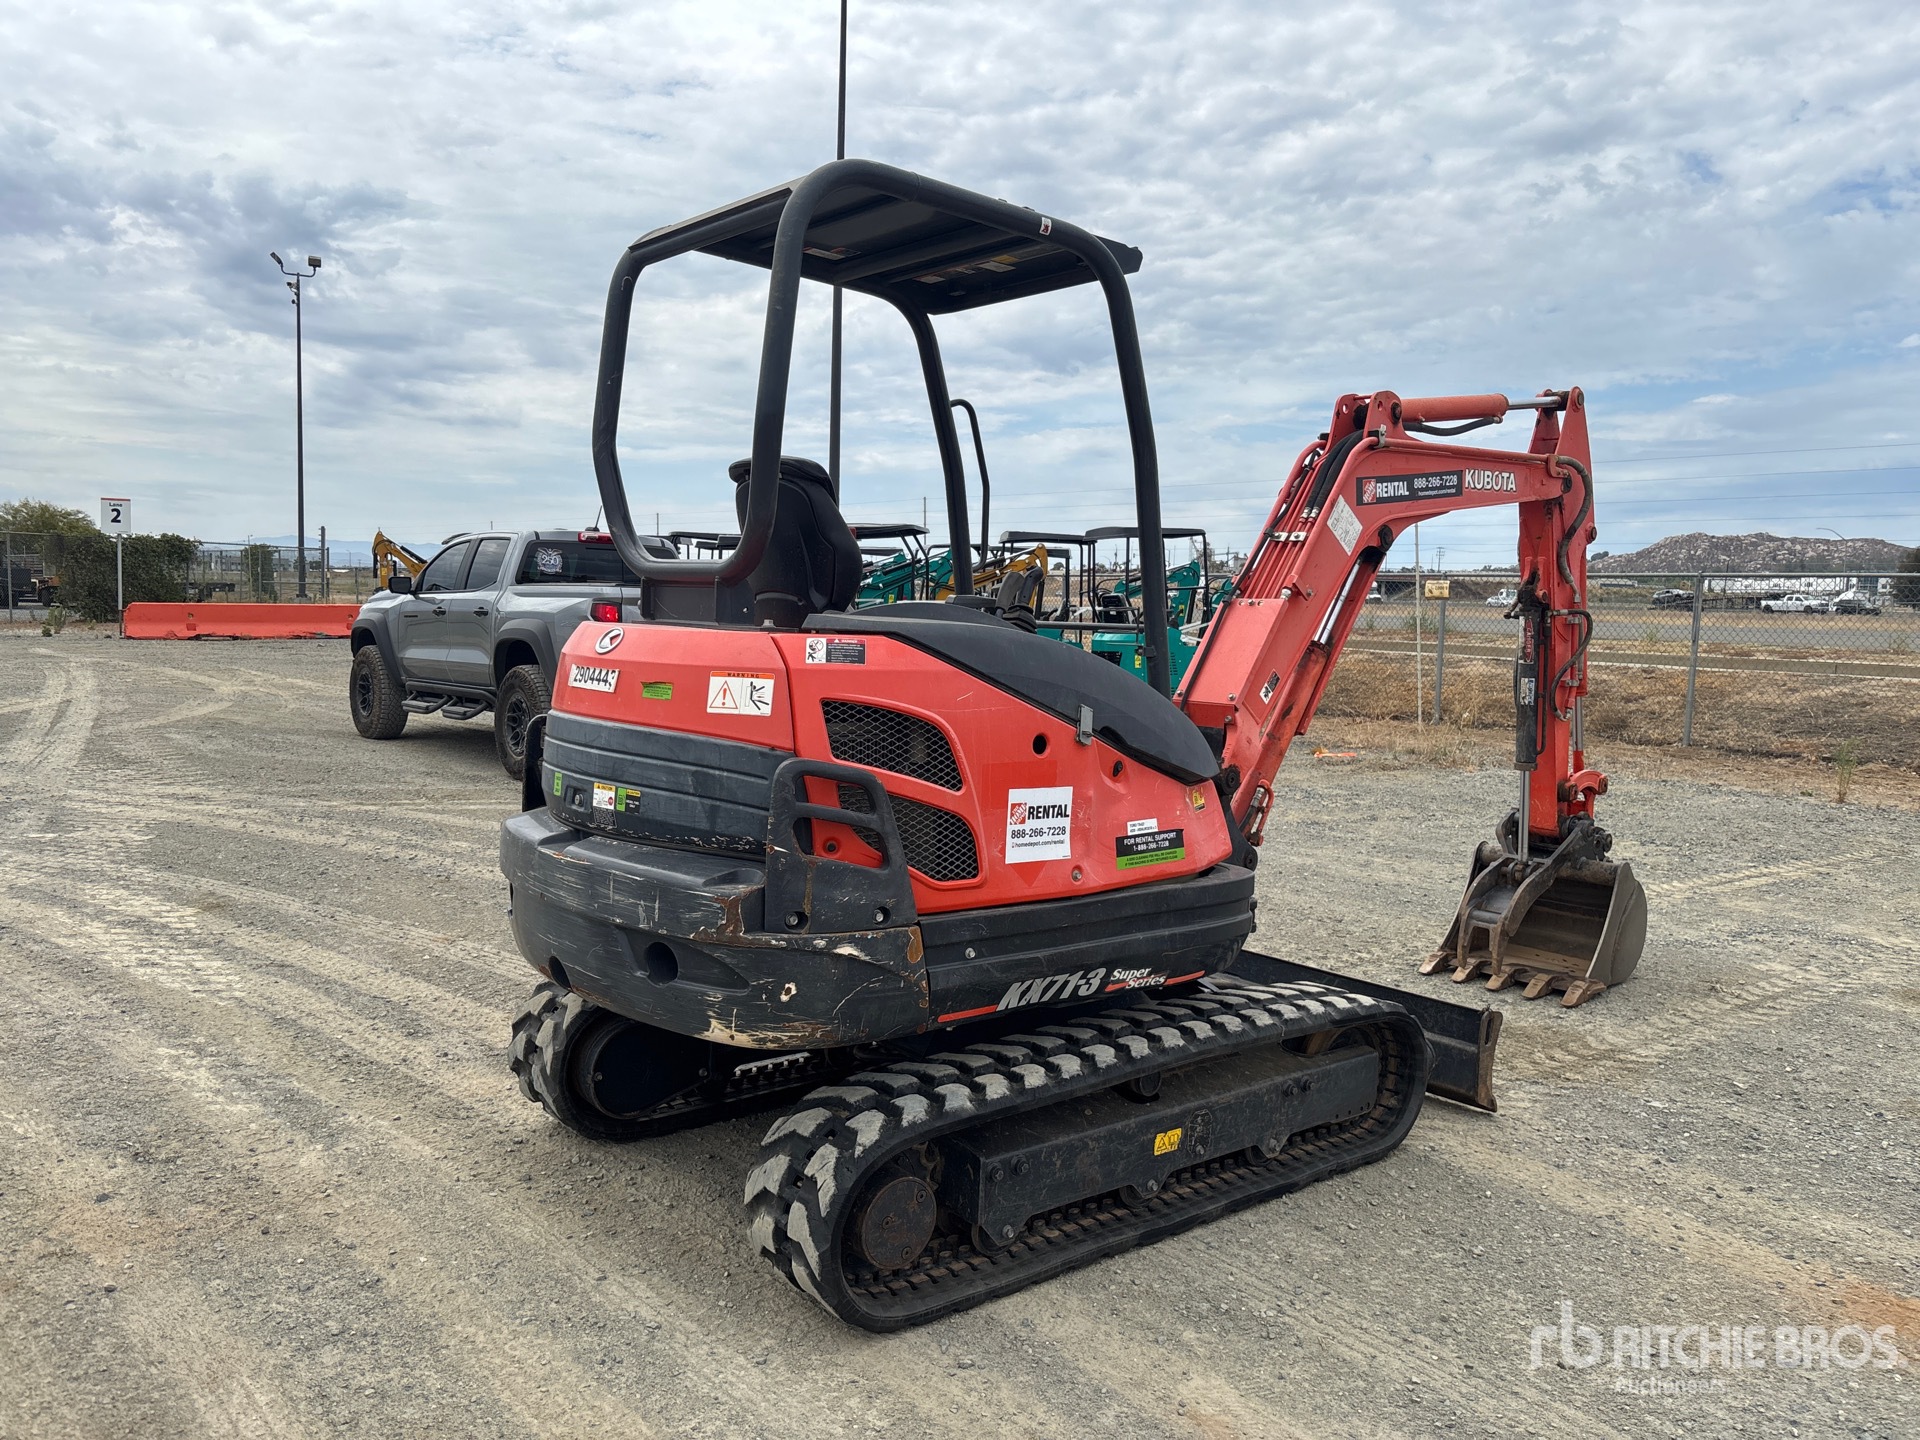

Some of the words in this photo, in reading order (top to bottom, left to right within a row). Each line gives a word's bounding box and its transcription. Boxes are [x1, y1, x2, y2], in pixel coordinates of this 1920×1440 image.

[1413, 475, 1458, 488] 888-266-7228
[1465, 469, 1517, 492] KUBOTA
[1376, 481, 1409, 498] RENTAL
[110, 508, 122, 523] 2
[541, 555, 559, 565] 250
[1027, 804, 1069, 820] RENTAL
[1011, 826, 1066, 839] 888-266-7228
[1135, 835, 1154, 844] RENTAL
[1154, 832, 1177, 840] SUPPORT
[1014, 839, 1065, 848] homedepot.com/rental
[1133, 840, 1169, 851] 1-888-266-7228
[1111, 968, 1152, 981] Super
[1126, 974, 1167, 989] Series
[996, 967, 1107, 1012] KX71-3
